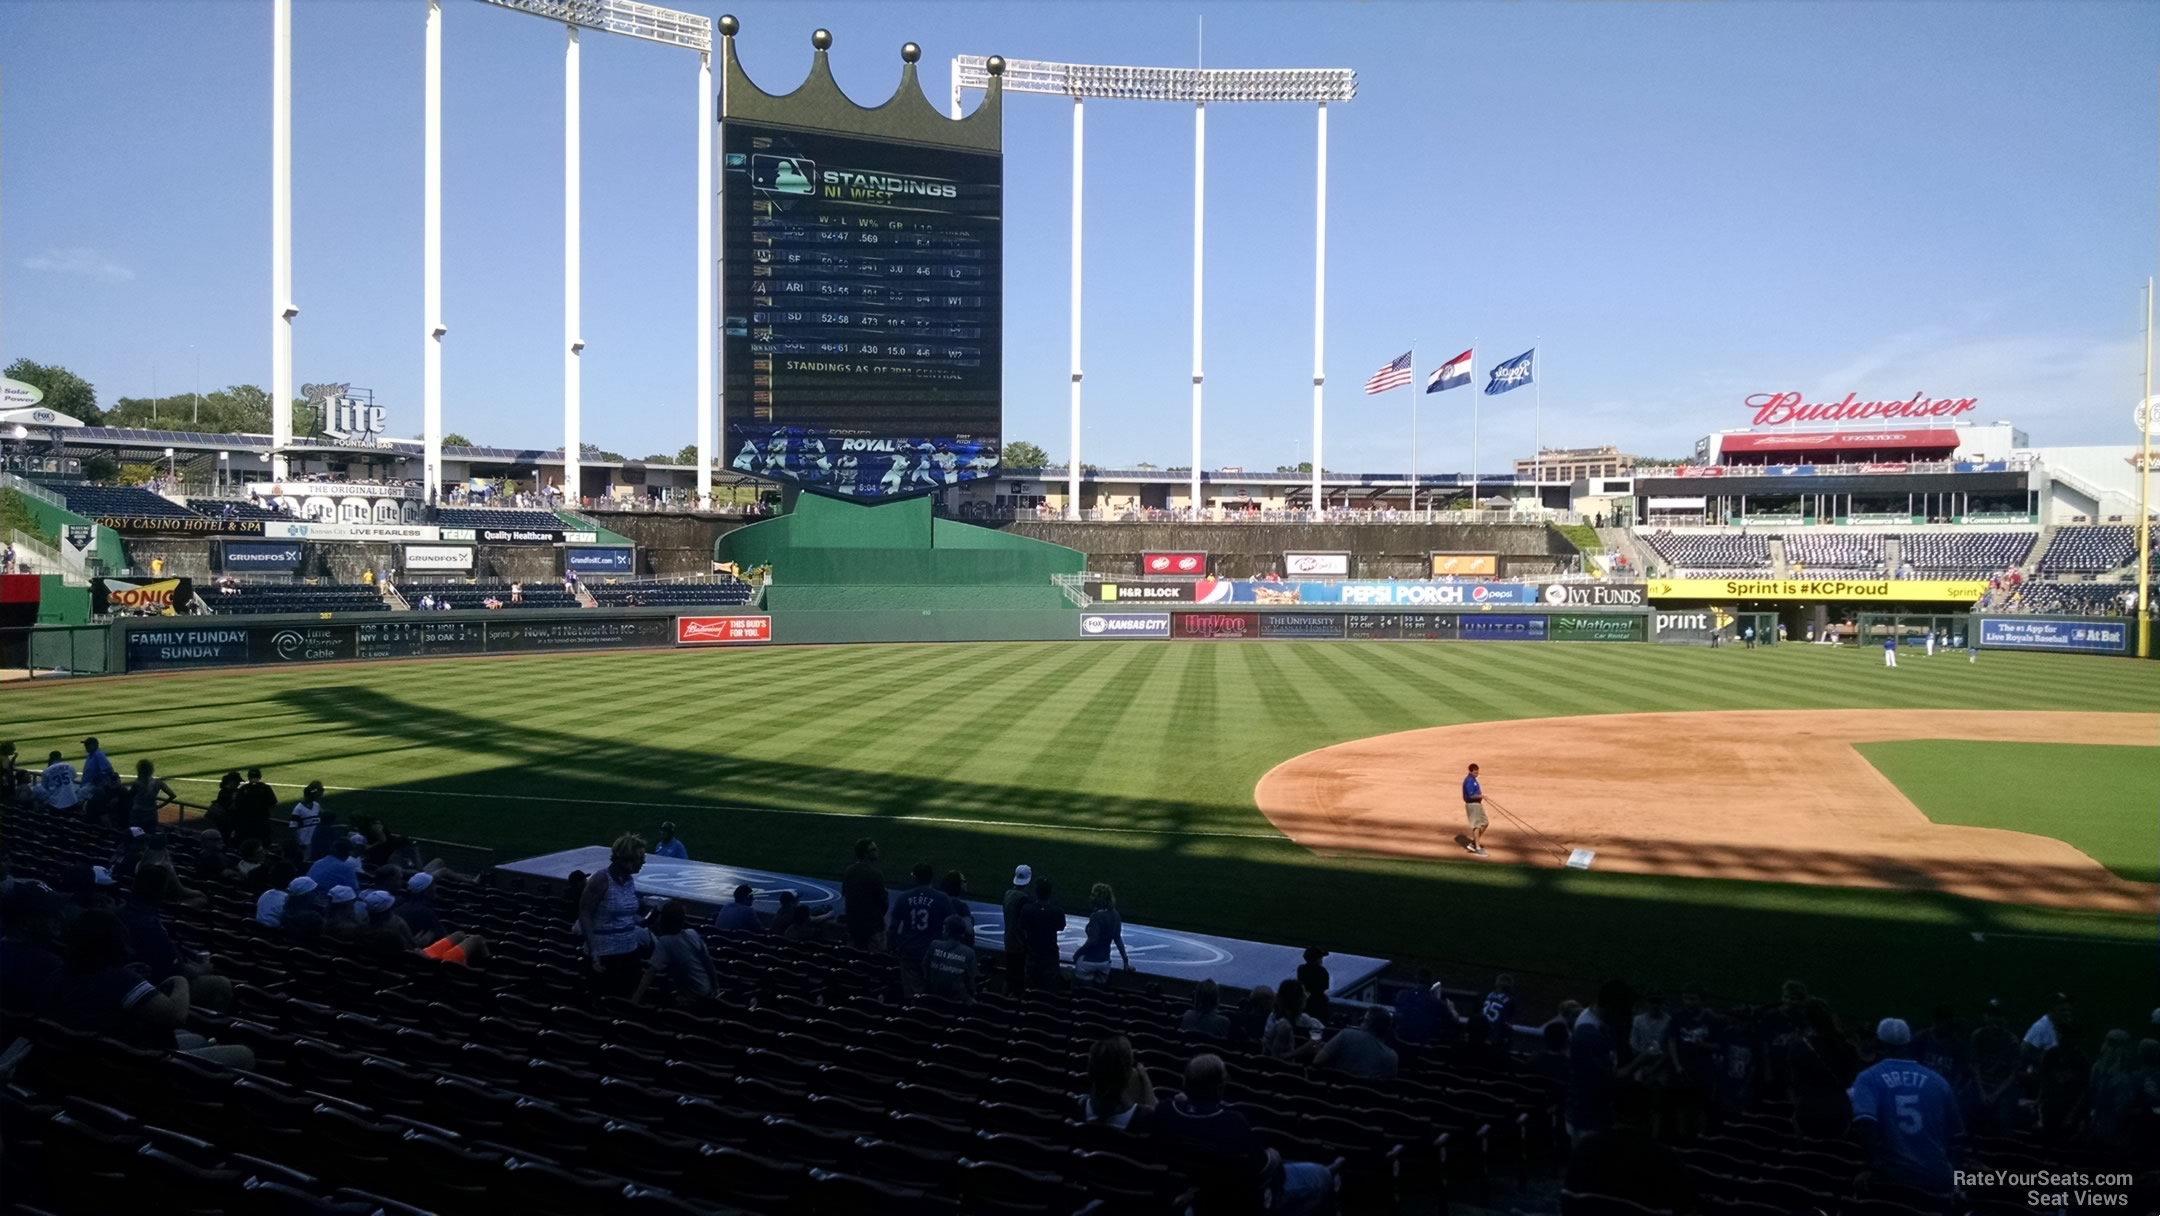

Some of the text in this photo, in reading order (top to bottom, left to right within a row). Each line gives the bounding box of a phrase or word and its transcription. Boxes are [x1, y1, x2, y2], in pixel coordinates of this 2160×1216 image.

[823, 171, 958, 199] STANDINGS
[851, 186, 894, 205] WEST
[819, 215, 830, 224] W
[858, 233, 879, 244] .569
[785, 283, 804, 293] ARI
[787, 312, 802, 322] SD
[887, 347, 906, 357] 15.0
[786, 360, 852, 374] STANDINGS
[855, 364, 870, 374] AS
[4, 387, 30, 395] Solar
[4, 395, 35, 403] Power
[1744, 391, 1979, 426] Budweiser
[322, 396, 387, 440] Lite
[334, 439, 394, 450] FOUNTAIN BAR
[309, 485, 328, 494] THE
[331, 486, 378, 496] ORIGINAL
[379, 487, 403, 497] LIGHT
[341, 503, 368, 523] Lite
[376, 505, 398, 523] Lite
[133, 517, 262, 533] CASINO HOTEL & SPA
[310, 527, 333, 535] Kansas
[334, 527, 346, 536] City
[373, 529, 421, 537] FEARLESS
[440, 529, 476, 541] TEVA
[484, 530, 553, 541] Quality Healthcare
[562, 531, 597, 542] TEVA
[228, 553, 285, 562] GRUNDFOS
[1119, 587, 1180, 598] H&R BLOCK
[1341, 585, 1464, 603] PEPSI PORCH
[1488, 590, 1513, 599] pepsi
[1726, 581, 1889, 597] Sprint is #KCProud
[1947, 587, 1978, 598] Sprint
[111, 589, 174, 607] SONIC
[1568, 587, 1642, 605] IVY FUNDS
[729, 620, 767, 628] THIS BUD'S
[1107, 619, 1146, 630] KANSAS
[1145, 619, 1168, 630] CITY
[1269, 616, 1335, 625] THE UNIVERSITY
[1575, 620, 1632, 632] National
[307, 629, 332, 638] Time
[489, 630, 510, 641] Sprint
[524, 626, 550, 638] Now,
[563, 624, 609, 637] Network
[609, 624, 619, 635] in
[620, 624, 636, 635] KC
[729, 629, 760, 637] FOR YOU.
[1272, 625, 1302, 633] KANSAS
[1303, 625, 1342, 633] HOSPITAL
[1465, 623, 1526, 633] UNITED
[1998, 623, 2014, 632] The
[2026, 624, 2043, 634] App
[2044, 624, 2057, 633] for
[131, 631, 246, 645] FAMILY FUNDAY
[360, 634, 377, 642] NYY
[425, 634, 436, 642] 30
[1986, 632, 2068, 643] Live Royals Baseball
[2086, 629, 2121, 642] At Bat
[160, 646, 221, 660] SUNDAY
[305, 649, 335, 659] Cable
[907, 896, 935, 907] PEREZ
[909, 907, 930, 932] 13
[1880, 1070, 1929, 1089] BRETT
[1894, 1094, 1924, 1134] 5
